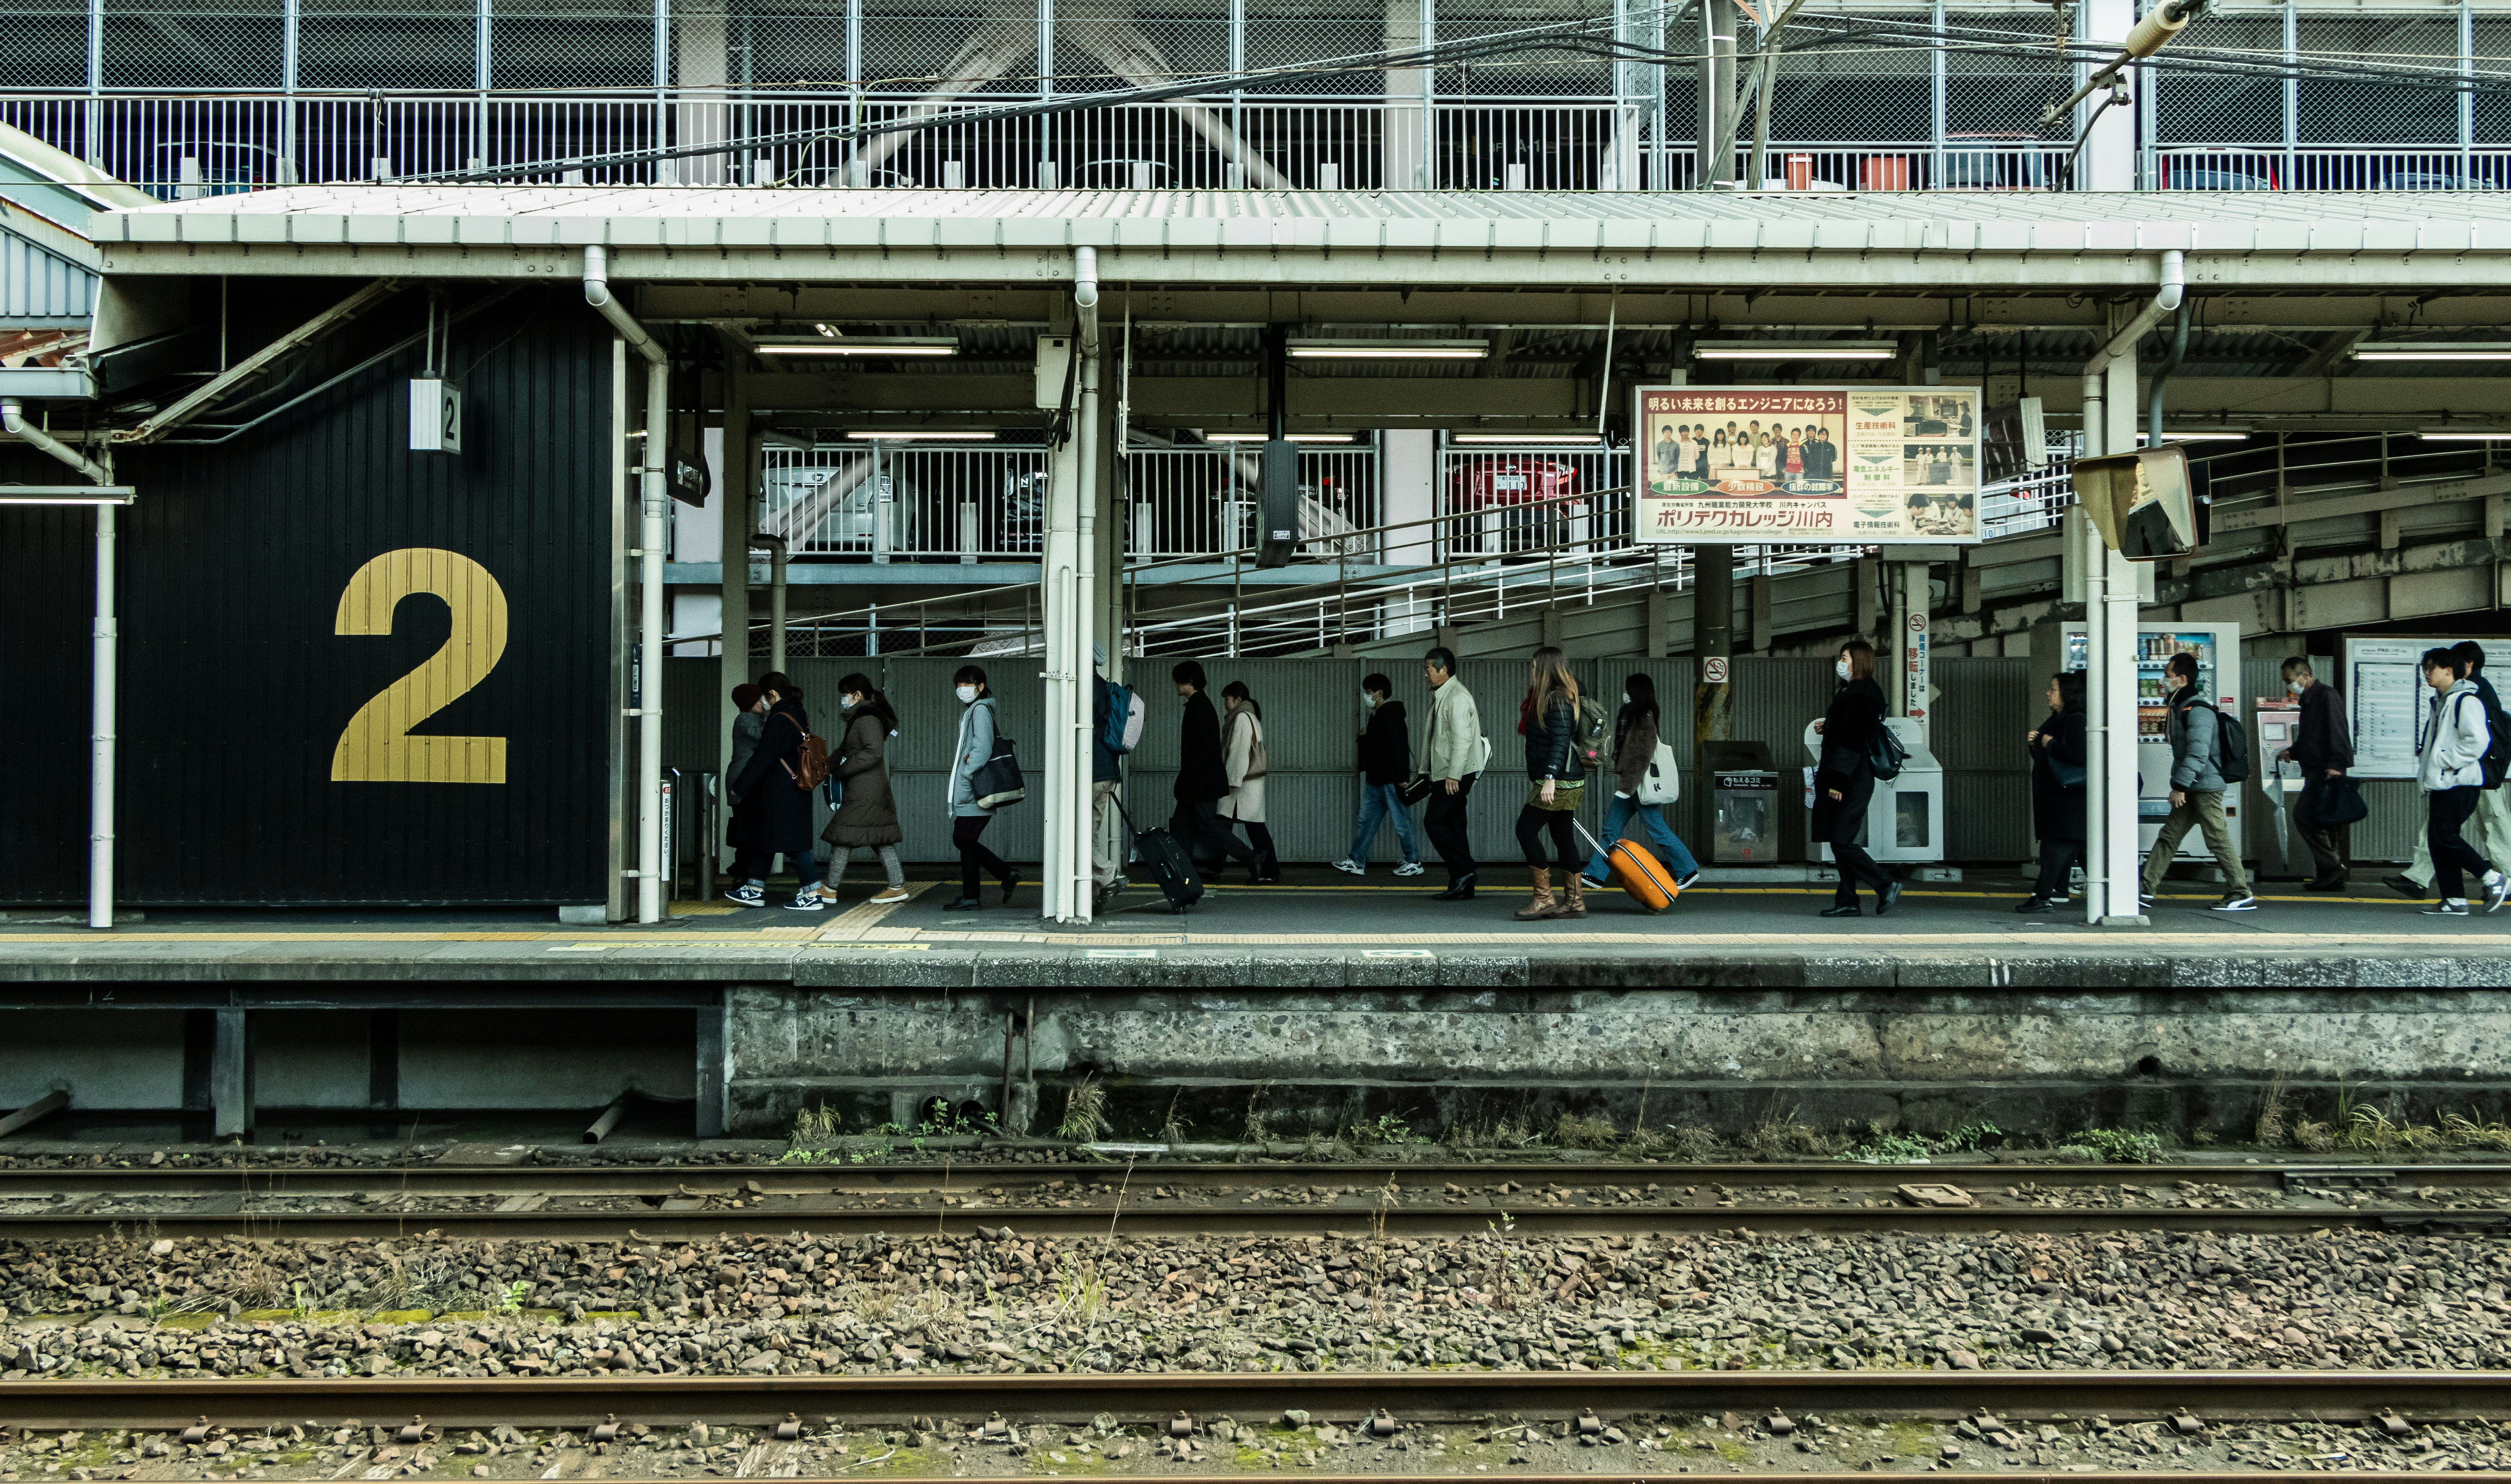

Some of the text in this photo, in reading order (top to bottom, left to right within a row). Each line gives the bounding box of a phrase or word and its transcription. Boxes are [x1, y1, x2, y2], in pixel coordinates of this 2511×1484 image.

[1648, 397, 1842, 411] 明るい未来を創るエンジニアになろう！
[445, 397, 455, 440] 2
[1663, 481, 1699, 492] 最新設備
[1728, 481, 1764, 492] 少数精鋭
[1789, 482, 1833, 492] 抜群の就職率
[1657, 509, 1833, 527] ポリテクカレッジ川内
[331, 547, 507, 784] 2
